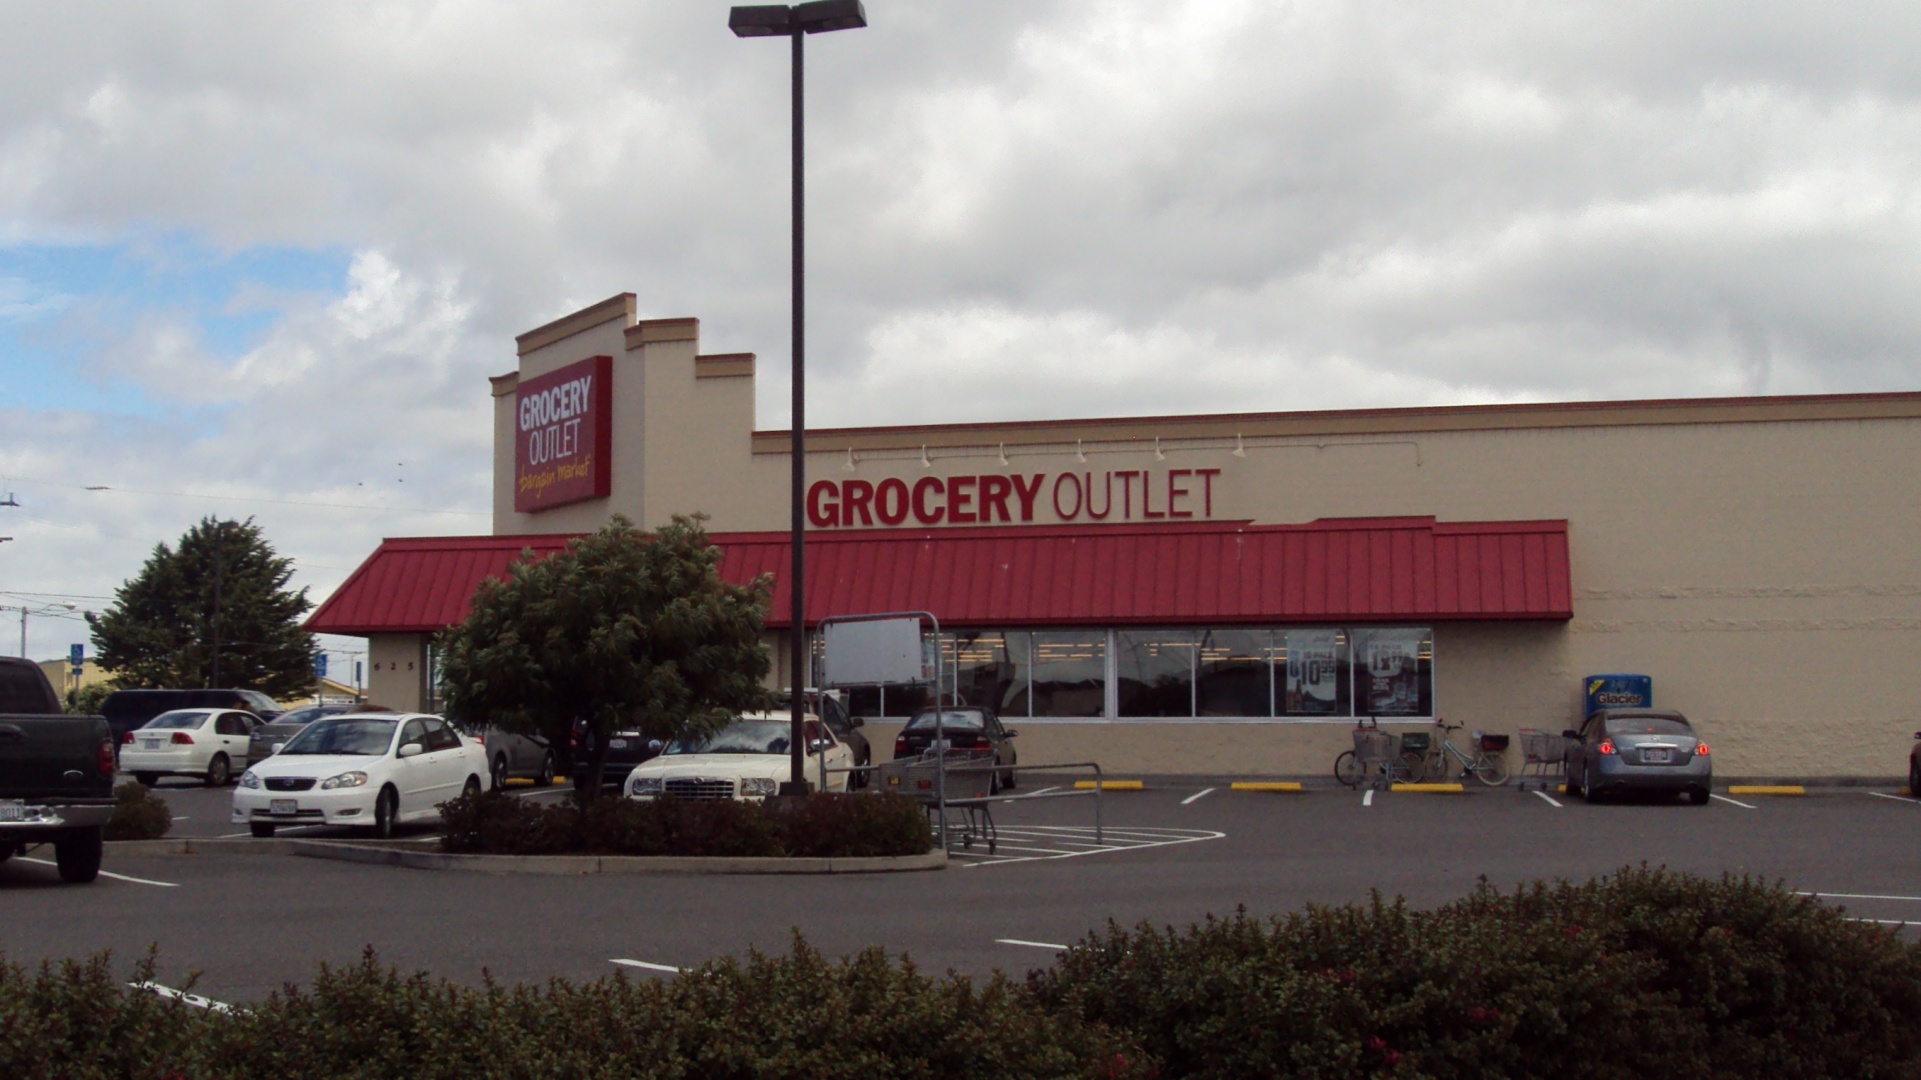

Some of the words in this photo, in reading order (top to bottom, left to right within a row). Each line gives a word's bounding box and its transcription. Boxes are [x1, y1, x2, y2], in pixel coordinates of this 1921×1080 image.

[520, 375, 592, 431] GROCERY
[529, 418, 581, 465] OUTLET
[519, 464, 555, 499] bargain
[557, 456, 590, 480] market
[806, 473, 1046, 528] GROCERY
[1053, 468, 1221, 520] OUTLET
[1597, 693, 1642, 704] Glacier
